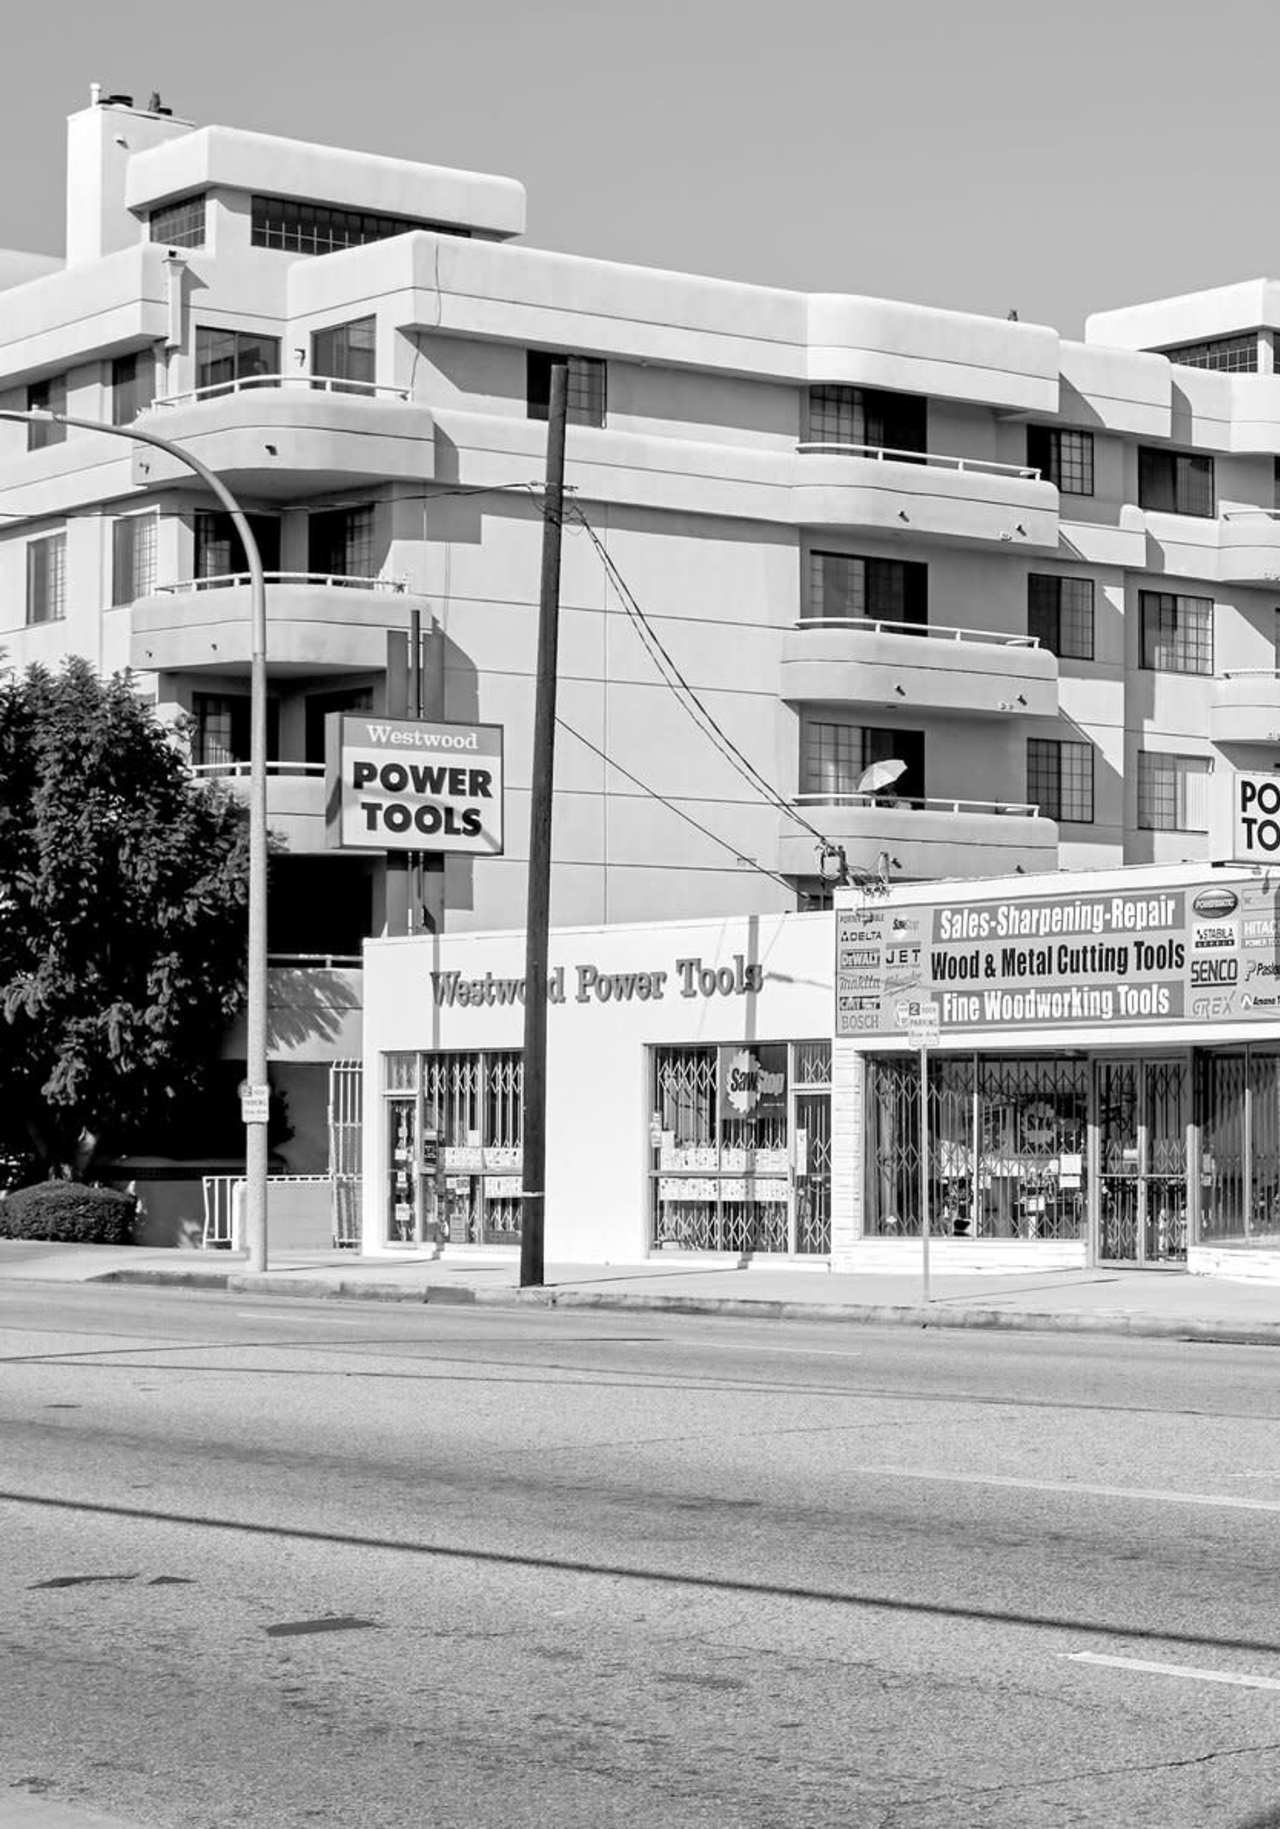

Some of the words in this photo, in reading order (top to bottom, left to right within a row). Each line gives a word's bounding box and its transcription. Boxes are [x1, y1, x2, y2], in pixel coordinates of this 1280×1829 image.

[367, 724, 479, 750] Westwood
[353, 761, 493, 799] POWER
[361, 802, 482, 837] TOOLS
[940, 895, 1176, 940] Sales-Sharpening-Repair
[850, 931, 881, 941] DELTA
[886, 949, 920, 964] JET
[931, 950, 980, 981] Wood
[984, 953, 996, 978] &
[1001, 946, 1053, 977] Metal
[1057, 943, 1129, 975] Cutting
[1133, 939, 1185, 971] Tools
[1190, 959, 1237, 982] SENCO
[431, 968, 566, 1007] Westwd
[576, 964, 667, 1004] Power
[676, 954, 764, 998] Tools
[943, 993, 980, 1022] Fine
[984, 987, 1113, 1020] Woodworking
[1117, 983, 1170, 1016] Tools
[841, 1015, 879, 1029] BOSCH
